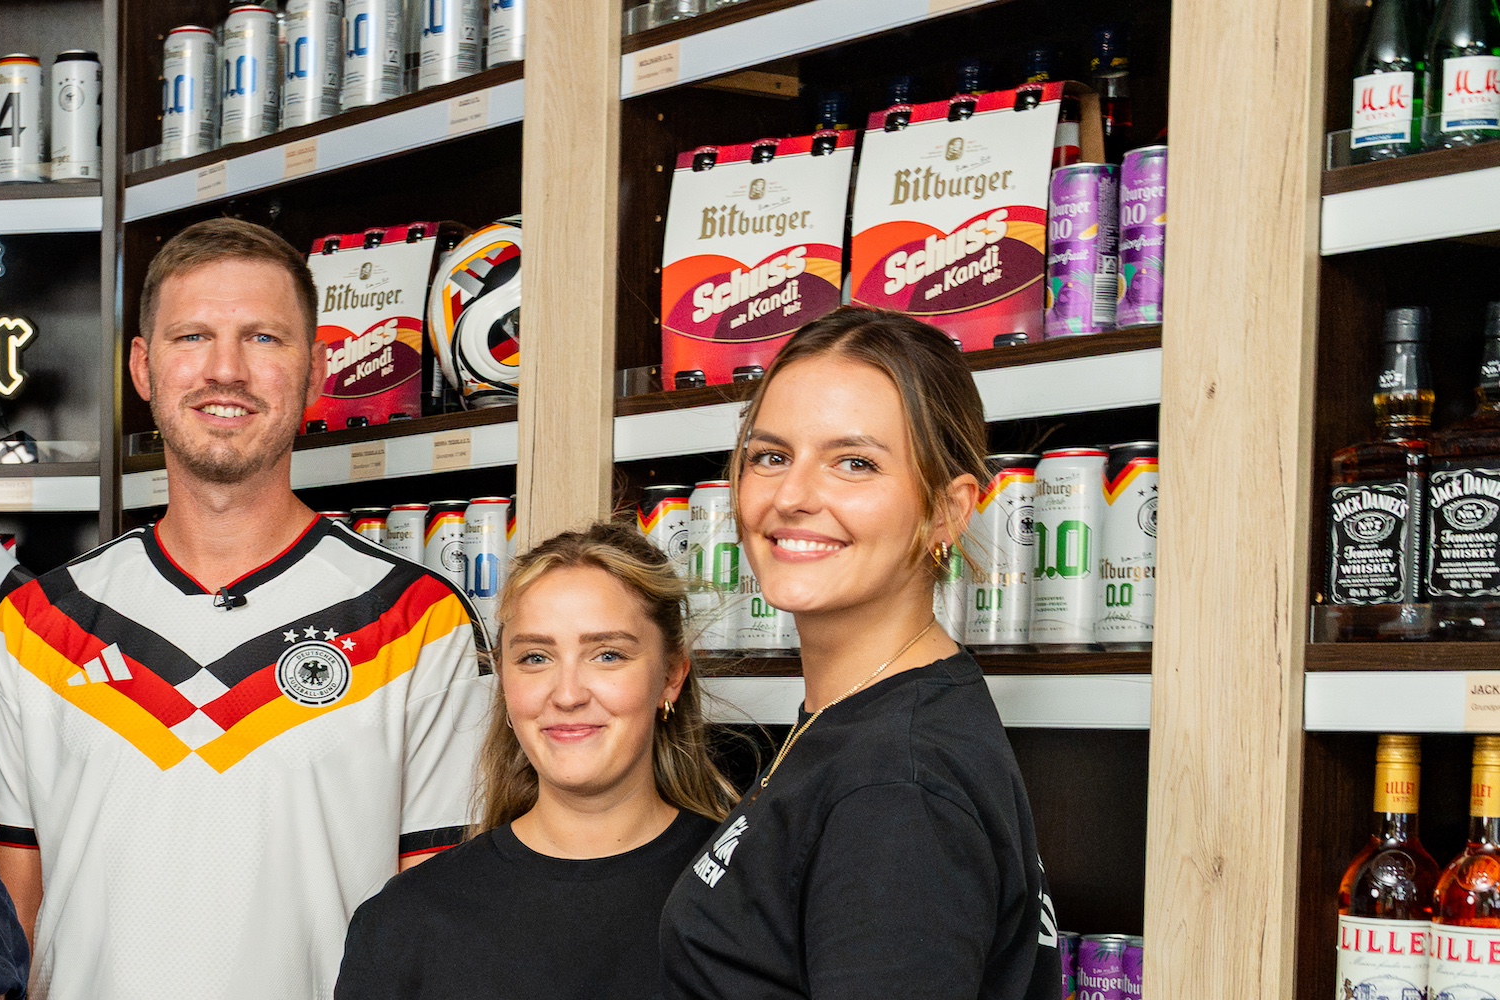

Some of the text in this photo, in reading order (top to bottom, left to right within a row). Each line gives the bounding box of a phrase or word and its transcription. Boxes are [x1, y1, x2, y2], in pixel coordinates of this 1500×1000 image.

[889, 165, 1013, 206] Bitburger
[697, 203, 811, 240] Bitburger
[884, 208, 1009, 296] Schuss
[691, 246, 807, 324] Schuss
[322, 282, 402, 313] Bitburger
[1430, 478, 1463, 508] JACK
[1332, 494, 1361, 522] JACK
[1441, 530, 1498, 544] Tennessee
[1343, 546, 1394, 559] Tennessee
[1441, 549, 1497, 559] WHISKEY
[1340, 563, 1397, 574] WHISKEY
[1105, 583, 1135, 608] 0.0
[296, 650, 336, 664] DEUTSCHER
[289, 676, 337, 696] FUSSBALL-BUND
[1471, 685, 1500, 696] JACK
[1385, 781, 1415, 796] LILLET
